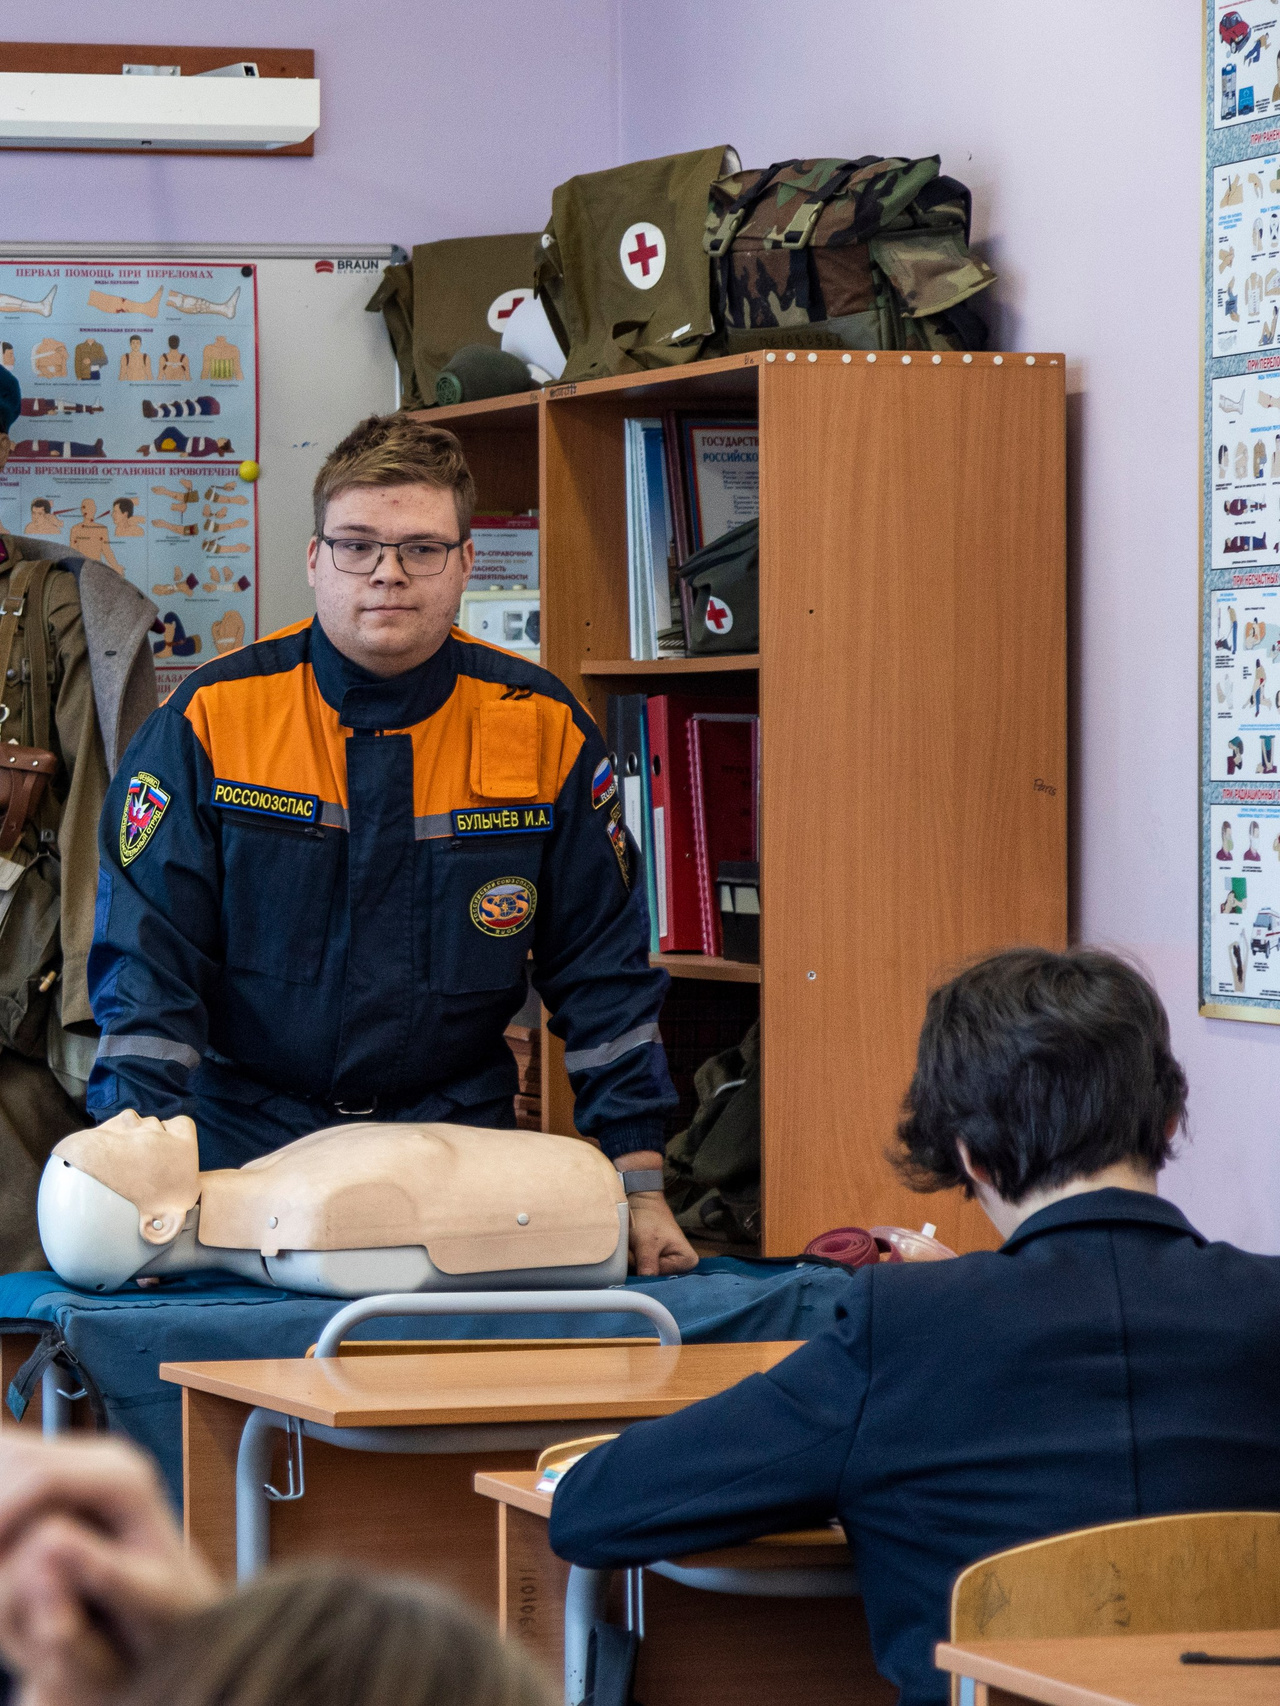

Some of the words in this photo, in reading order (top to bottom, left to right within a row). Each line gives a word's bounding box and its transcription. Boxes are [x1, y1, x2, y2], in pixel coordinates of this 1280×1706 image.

[337, 260, 379, 269] BRAUN
[16, 268, 60, 277] ПЕРВАЯ
[65, 269, 114, 278] ПОМОЩЬ
[119, 269, 142, 278] ПРИ
[146, 270, 214, 279] ПЕРЕЛОМАХ
[703, 449, 759, 462] РОССИЙСКО
[35, 466, 98, 476] ВРЕМЕННОЙ
[102, 466, 165, 476] ОСТАНОВКИ
[170, 467, 240, 477] КРОВОТЕЧЕНИ
[1244, 572, 1279, 586] НЕСЧАСТНЫХ
[214, 784, 314, 817] РОССОЮЗСПАС
[1234, 788, 1276, 801] РАДИАЦИОННЫХ
[147, 811, 162, 834] ОТРЯД
[456, 810, 520, 831] БУЛЫЧЁВ
[524, 809, 551, 827] И.А.
